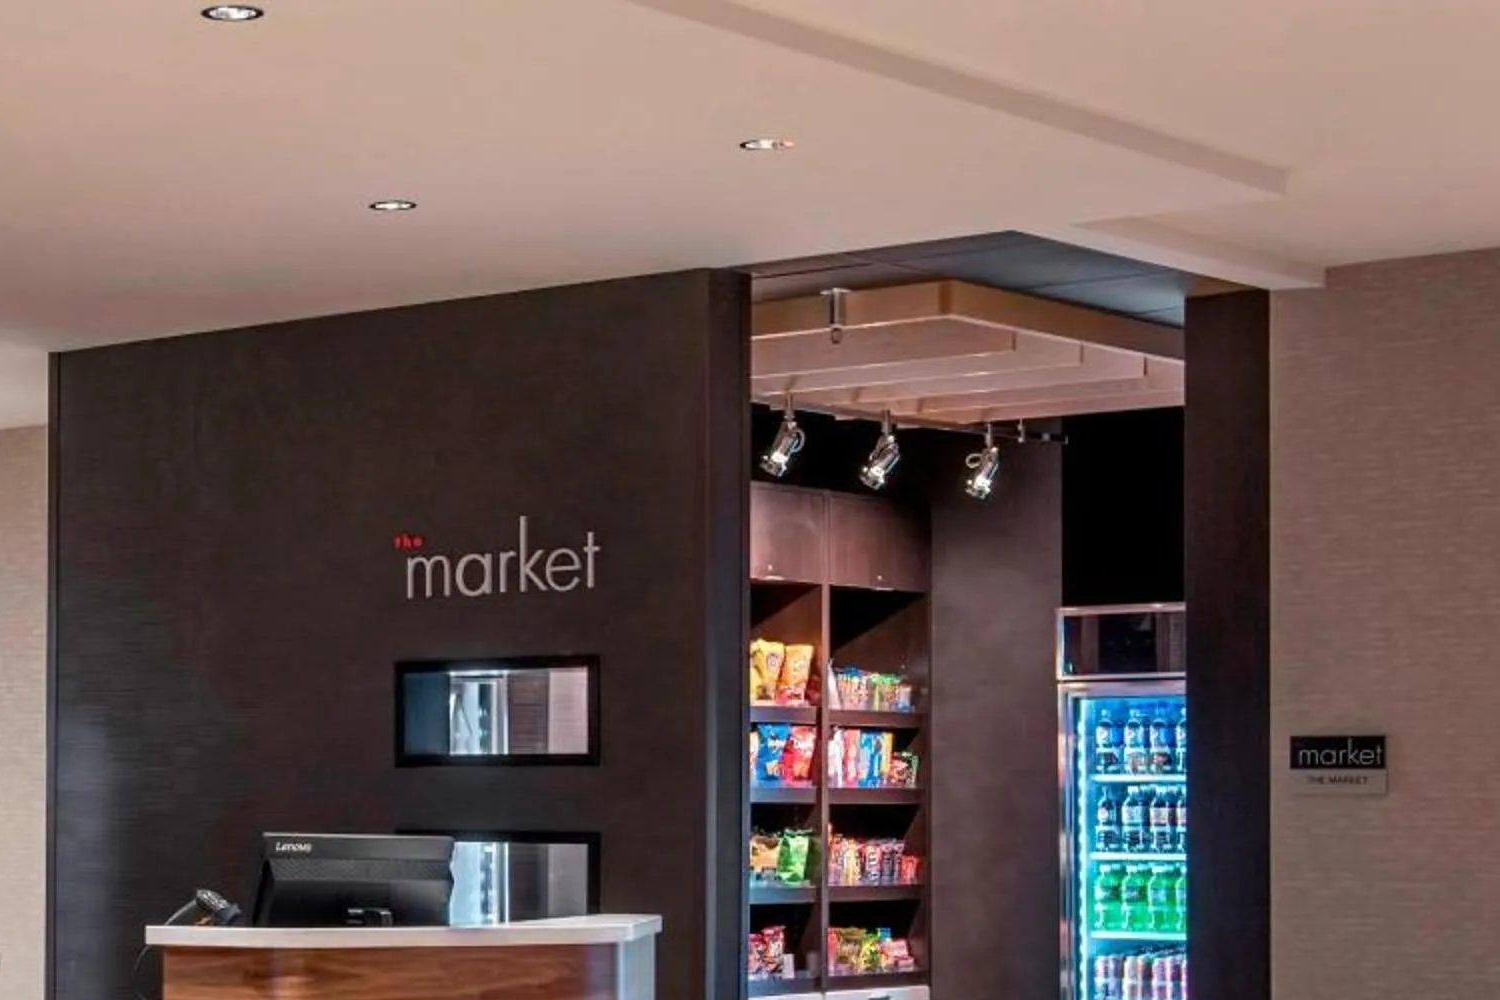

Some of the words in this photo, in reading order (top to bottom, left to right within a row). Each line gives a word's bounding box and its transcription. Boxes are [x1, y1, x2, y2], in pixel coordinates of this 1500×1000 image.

[407, 515, 601, 599] market
[1299, 738, 1381, 765] market
[276, 841, 313, 853] Lenovo
